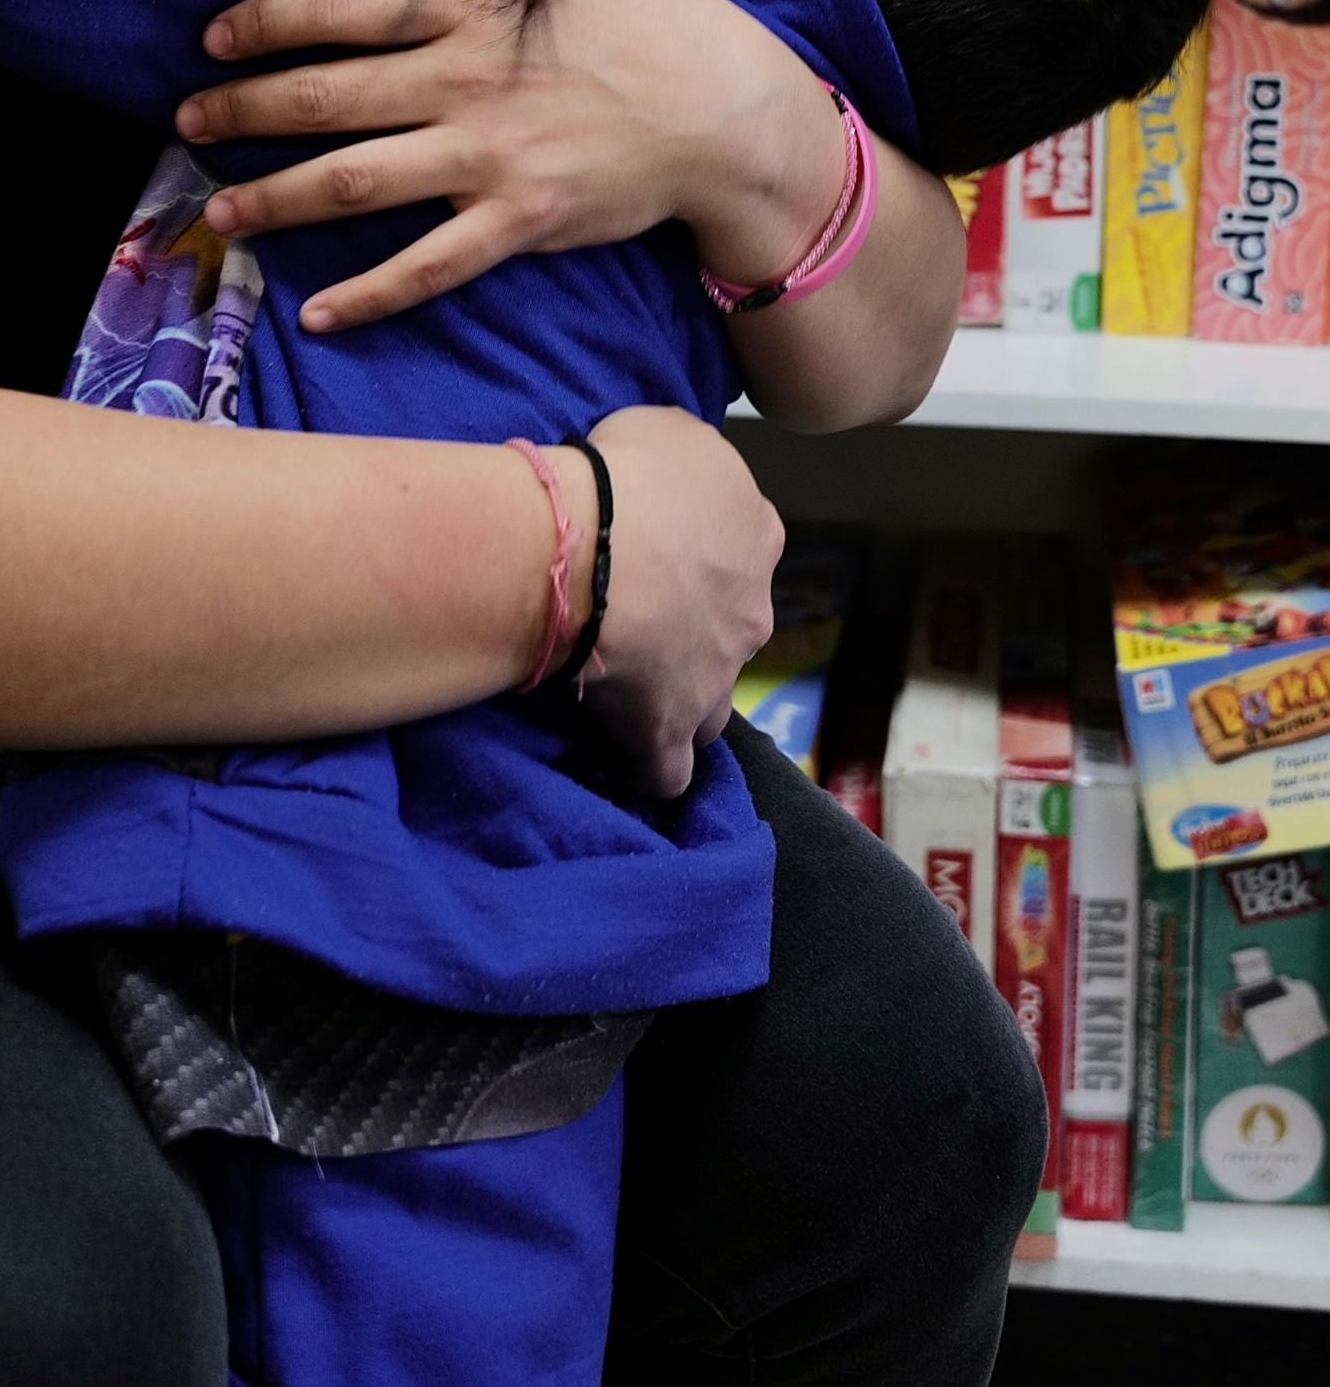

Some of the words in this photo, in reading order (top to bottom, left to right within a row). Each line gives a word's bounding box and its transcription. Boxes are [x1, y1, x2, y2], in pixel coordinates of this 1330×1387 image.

[1215, 76, 1300, 307] Adigma
[1084, 898, 1128, 983] RAIL
[1082, 995, 1127, 1093] KING
